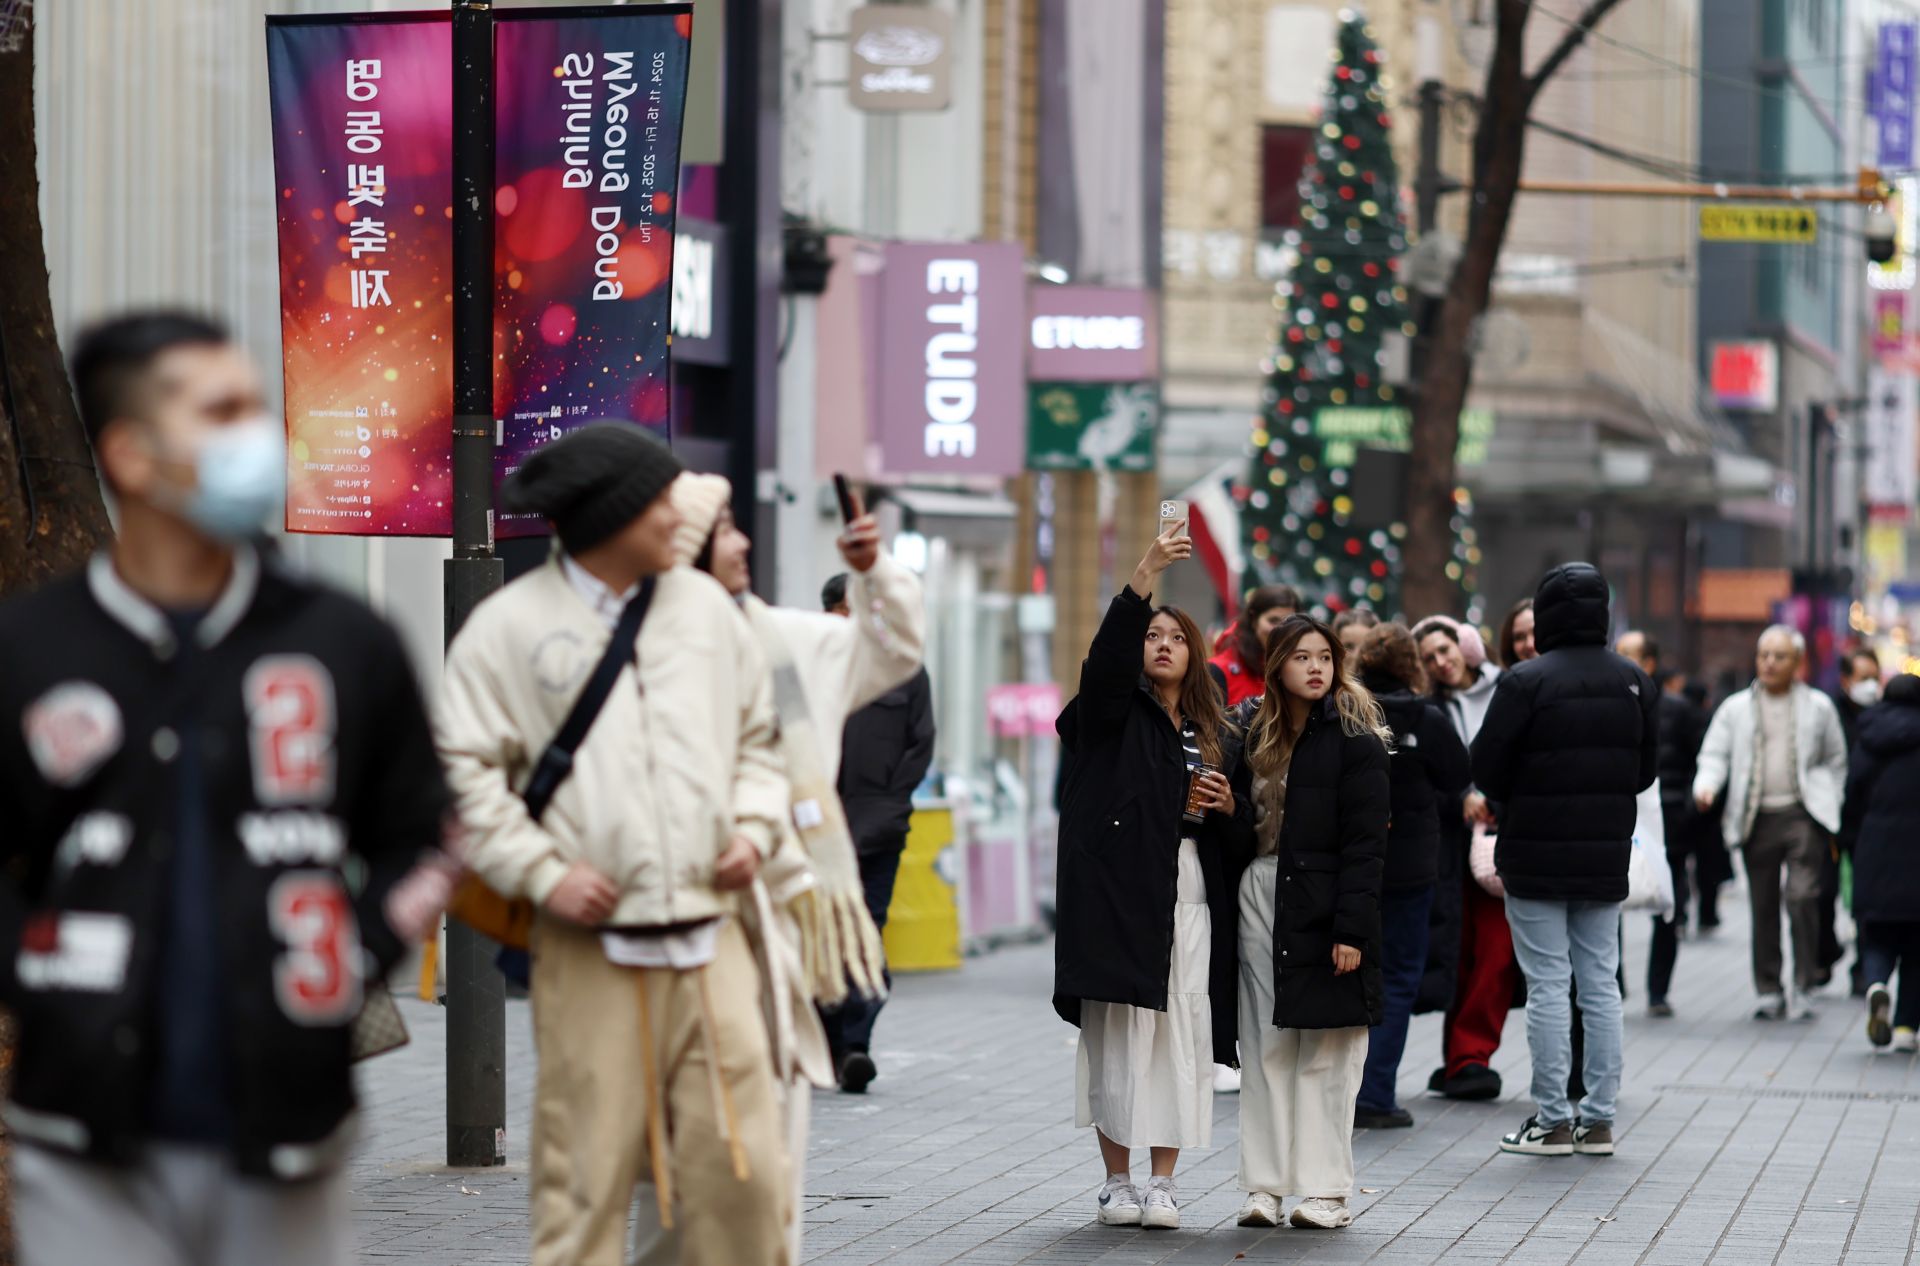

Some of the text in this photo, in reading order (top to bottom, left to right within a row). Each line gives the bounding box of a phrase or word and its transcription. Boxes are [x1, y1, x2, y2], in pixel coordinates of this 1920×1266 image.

[925, 258, 978, 458] ETUDE
[1031, 315, 1144, 350] ETUDE
[242, 652, 338, 807] 2
[268, 870, 362, 1027] 3
